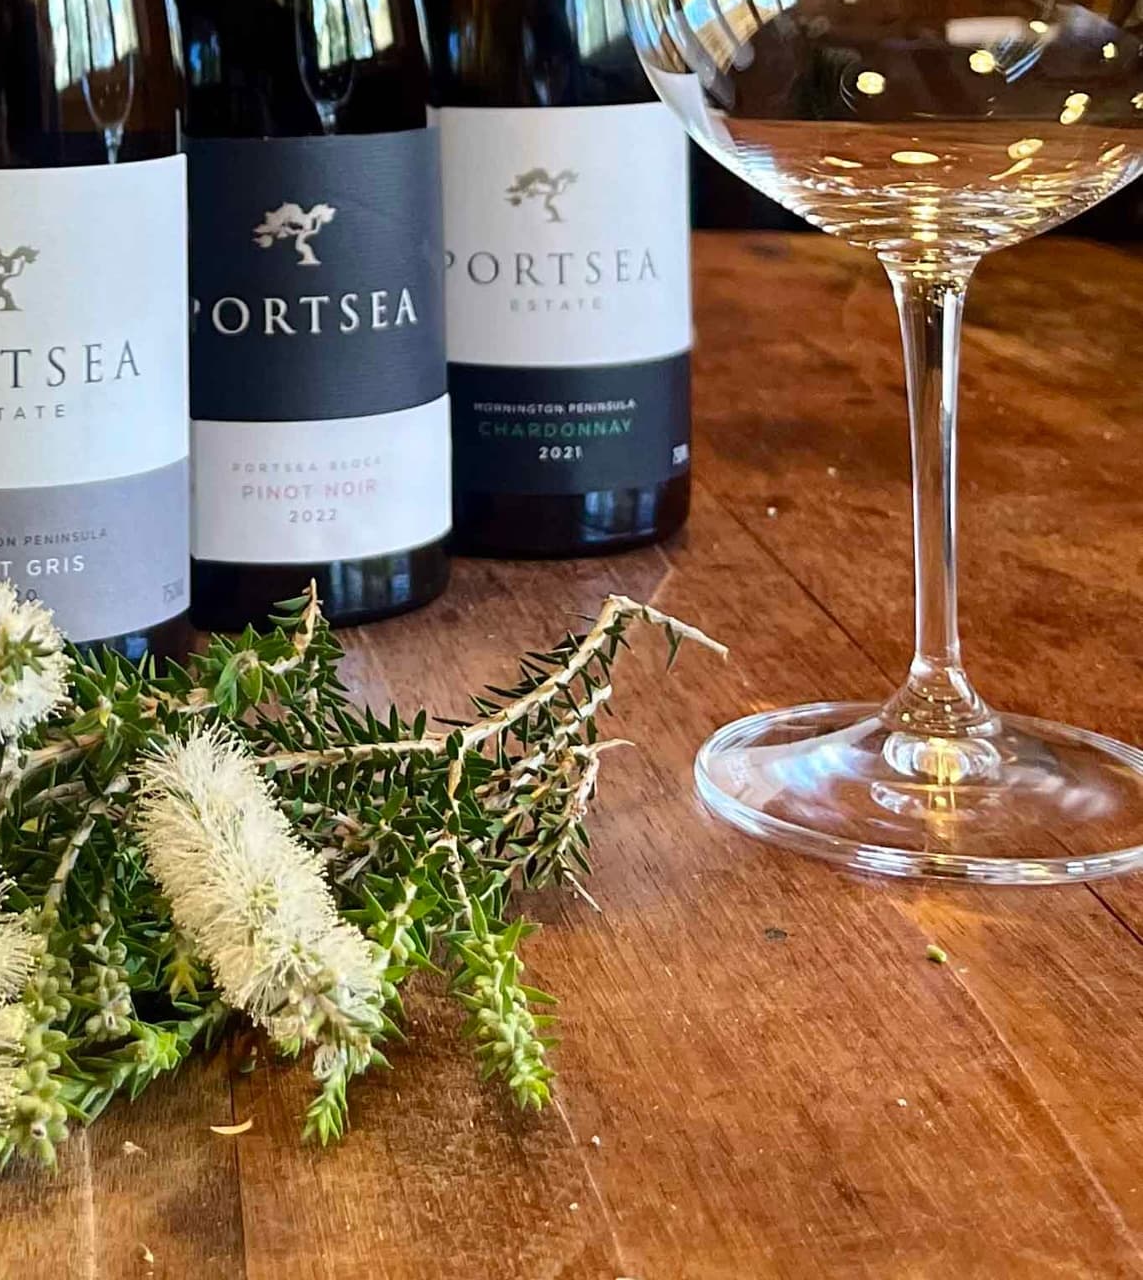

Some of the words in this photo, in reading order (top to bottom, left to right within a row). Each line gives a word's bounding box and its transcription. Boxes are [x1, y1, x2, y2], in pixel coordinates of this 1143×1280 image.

[192, 287, 417, 334] ORTSEA
[510, 297, 602, 312] ESTATE
[474, 401, 564, 415] MORNINGTON
[568, 398, 636, 412] PENINSULA
[478, 420, 632, 438] CHARDONNAY
[538, 445, 583, 460] 2021
[241, 484, 314, 500] PINOT
[324, 478, 377, 497] NOIR
[289, 508, 338, 523] 2022
[23, 528, 108, 546] PENINSULA
[26, 555, 85, 576] GRIS
